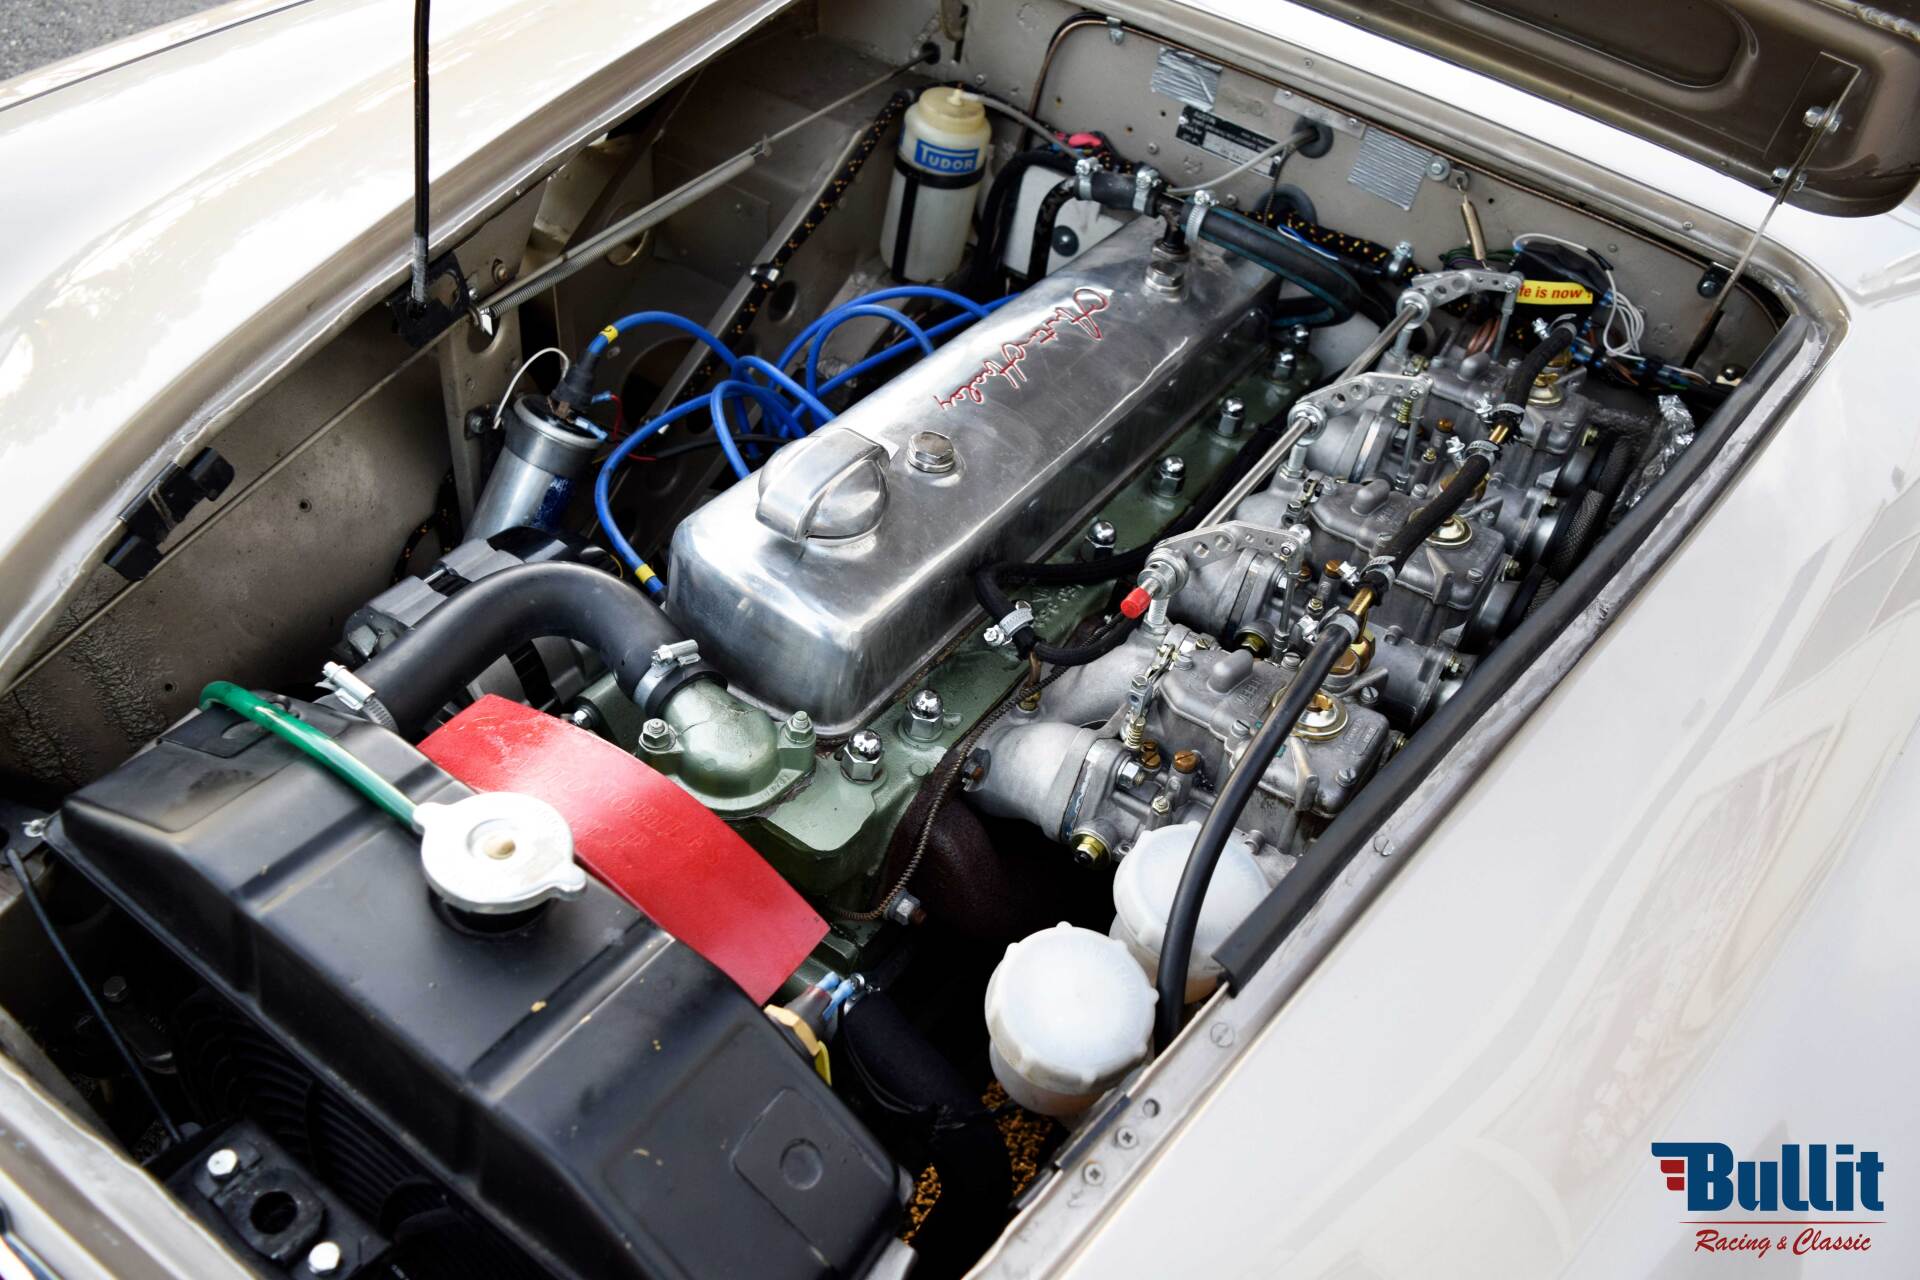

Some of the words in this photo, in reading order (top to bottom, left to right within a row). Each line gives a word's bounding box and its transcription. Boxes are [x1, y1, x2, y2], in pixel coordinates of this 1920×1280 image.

[919, 143, 977, 170] TUDOR
[1536, 286, 1548, 298] is
[1551, 288, 1583, 299] now
